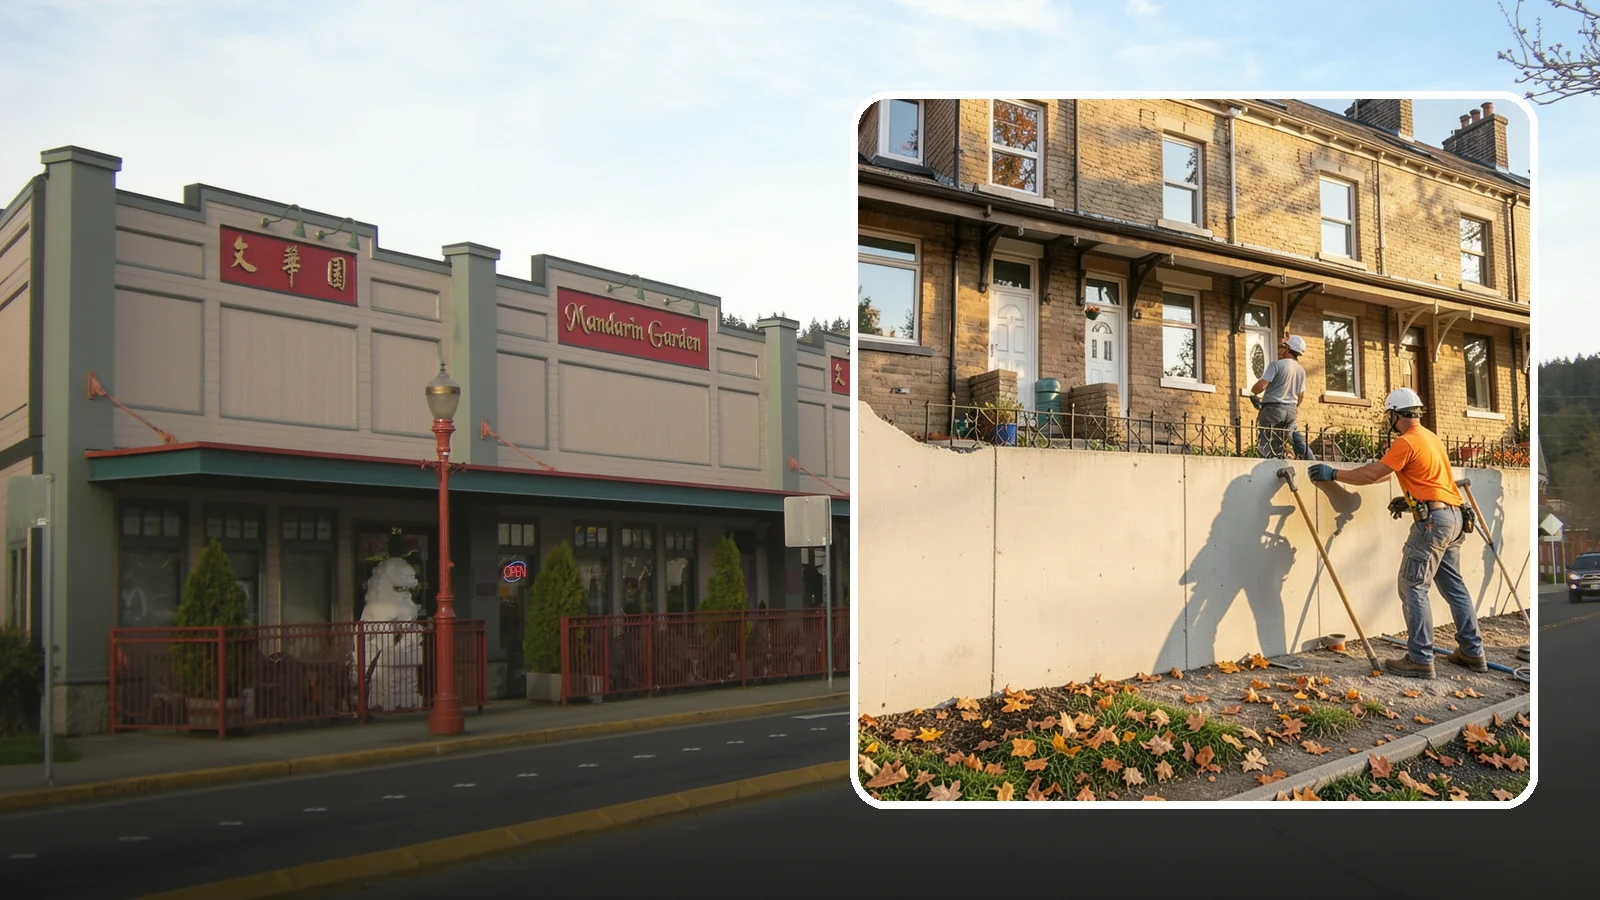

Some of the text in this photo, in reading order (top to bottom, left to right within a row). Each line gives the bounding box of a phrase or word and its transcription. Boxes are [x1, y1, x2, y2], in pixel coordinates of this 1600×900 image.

[230, 235, 346, 291] 文華園
[564, 302, 701, 352] Mandarin Garden
[503, 565, 527, 578] OPEN
